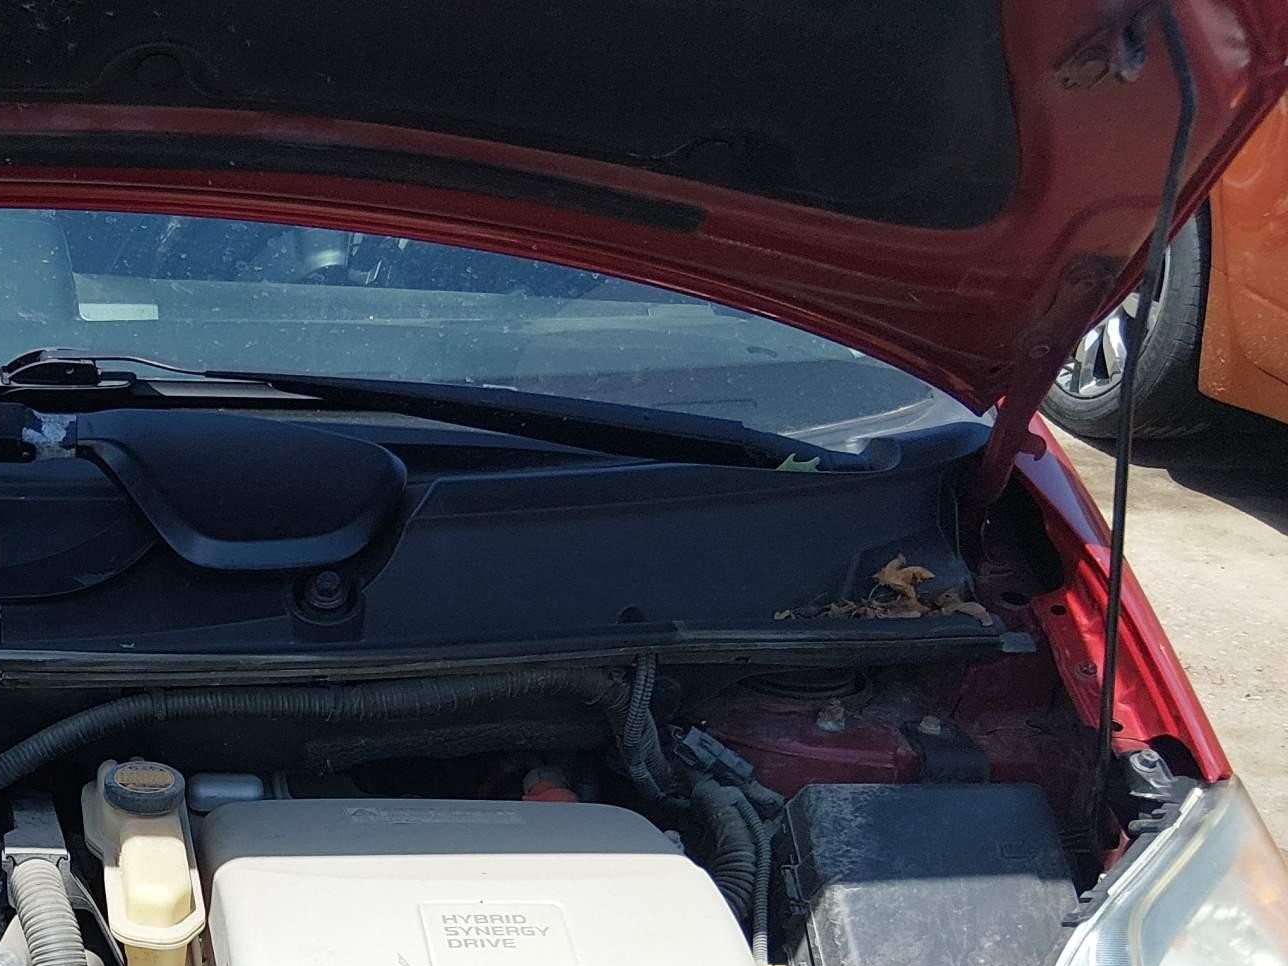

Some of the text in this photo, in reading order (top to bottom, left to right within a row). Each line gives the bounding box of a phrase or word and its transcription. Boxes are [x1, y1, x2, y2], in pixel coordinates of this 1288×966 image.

[441, 914, 527, 924] HYBRID
[443, 926, 550, 936] SYNERGY
[447, 938, 517, 949] DRIVE
